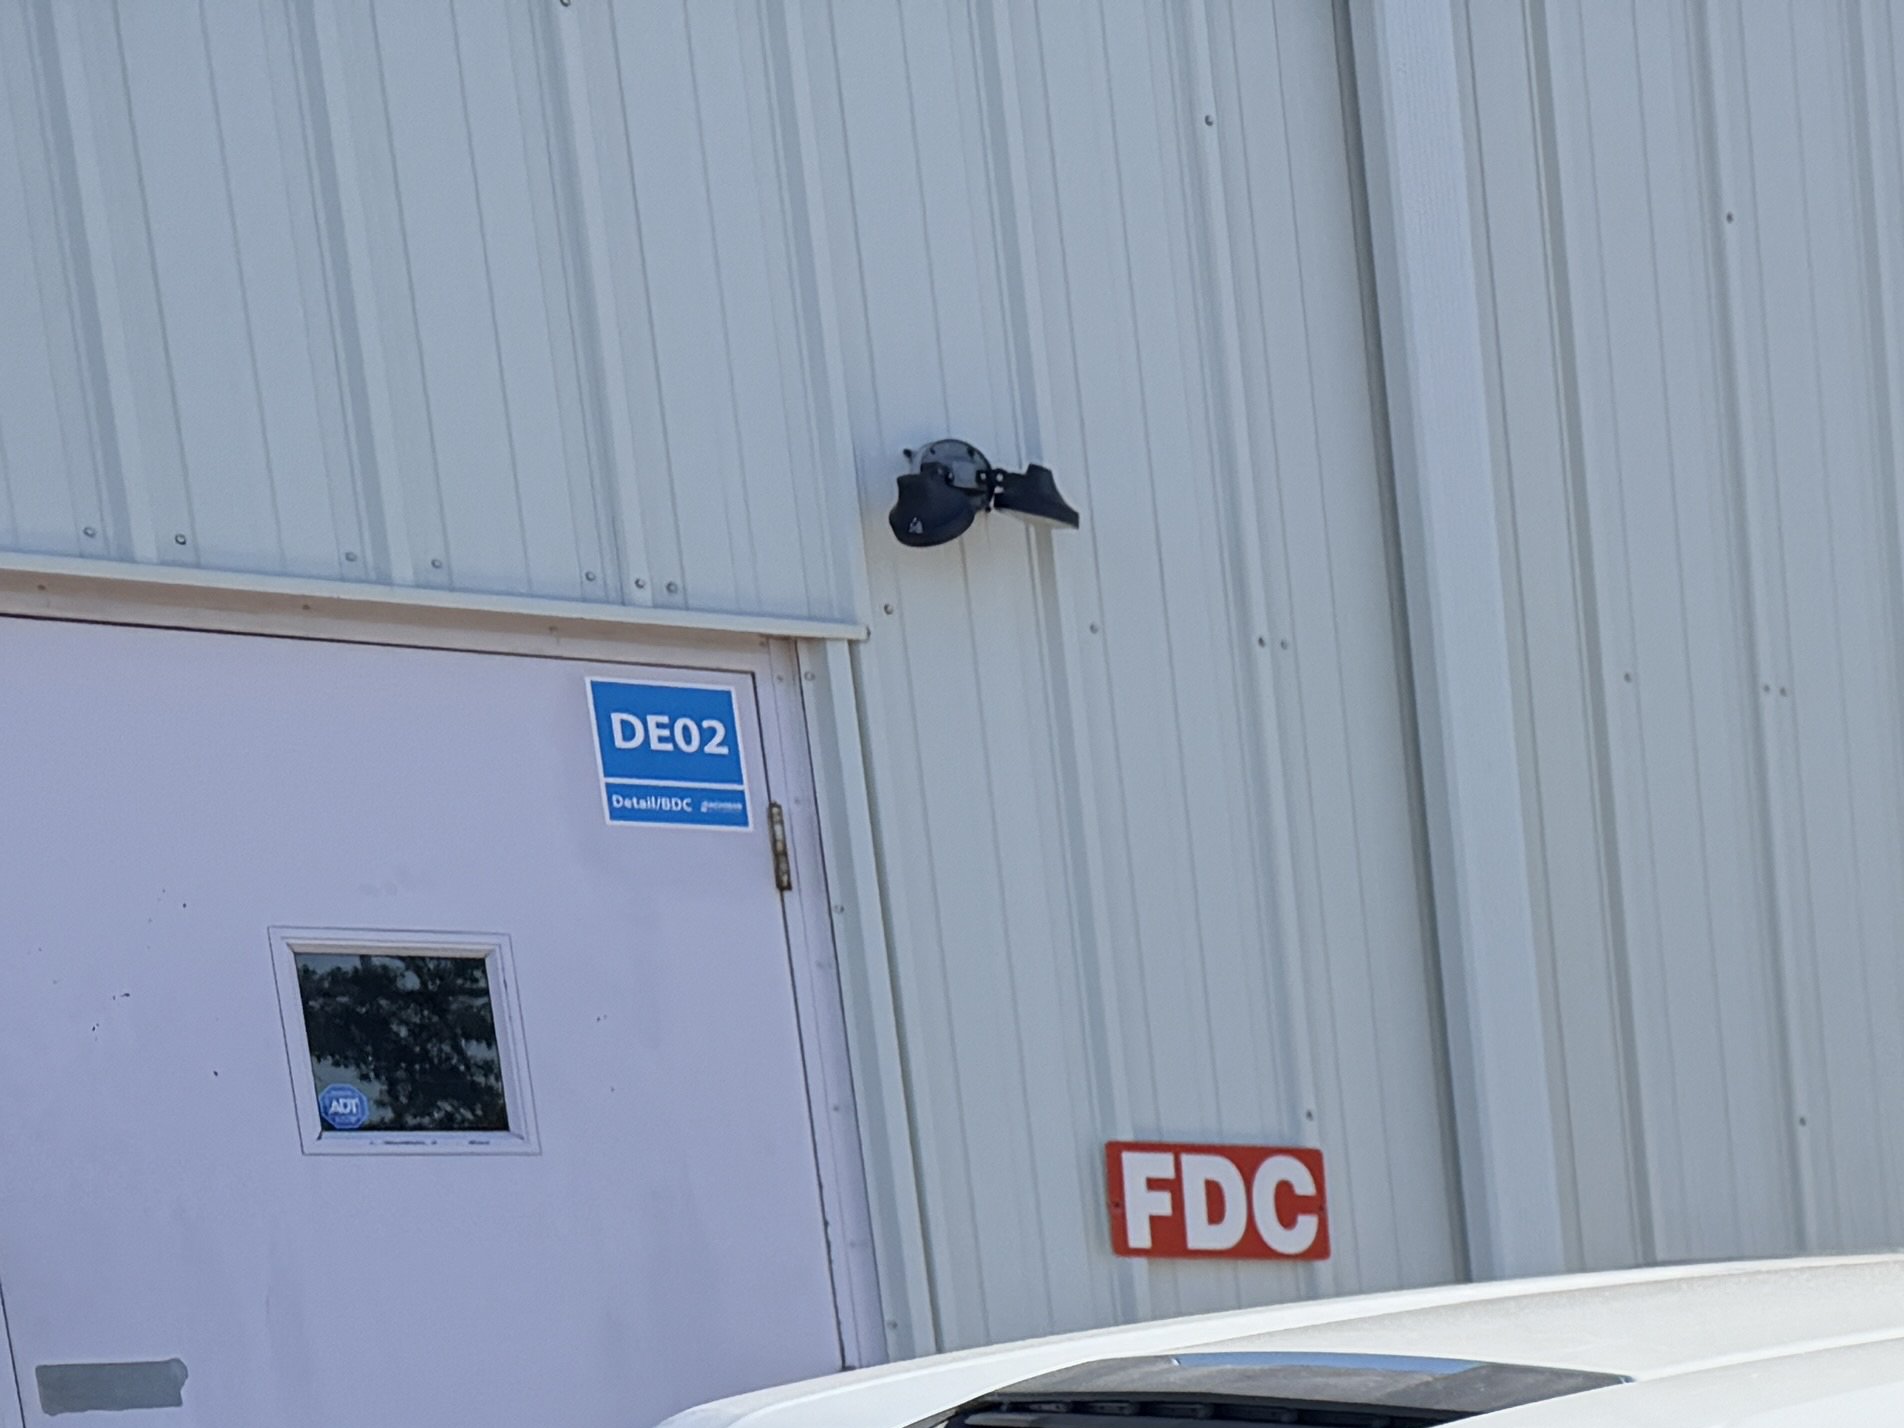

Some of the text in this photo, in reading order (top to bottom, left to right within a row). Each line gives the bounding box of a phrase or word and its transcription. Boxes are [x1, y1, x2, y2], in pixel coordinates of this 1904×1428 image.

[610, 712, 729, 756] DE02
[612, 794, 693, 812] Detail/BDC
[329, 1097, 359, 1115] ADT
[1121, 1151, 1320, 1255] FDC
